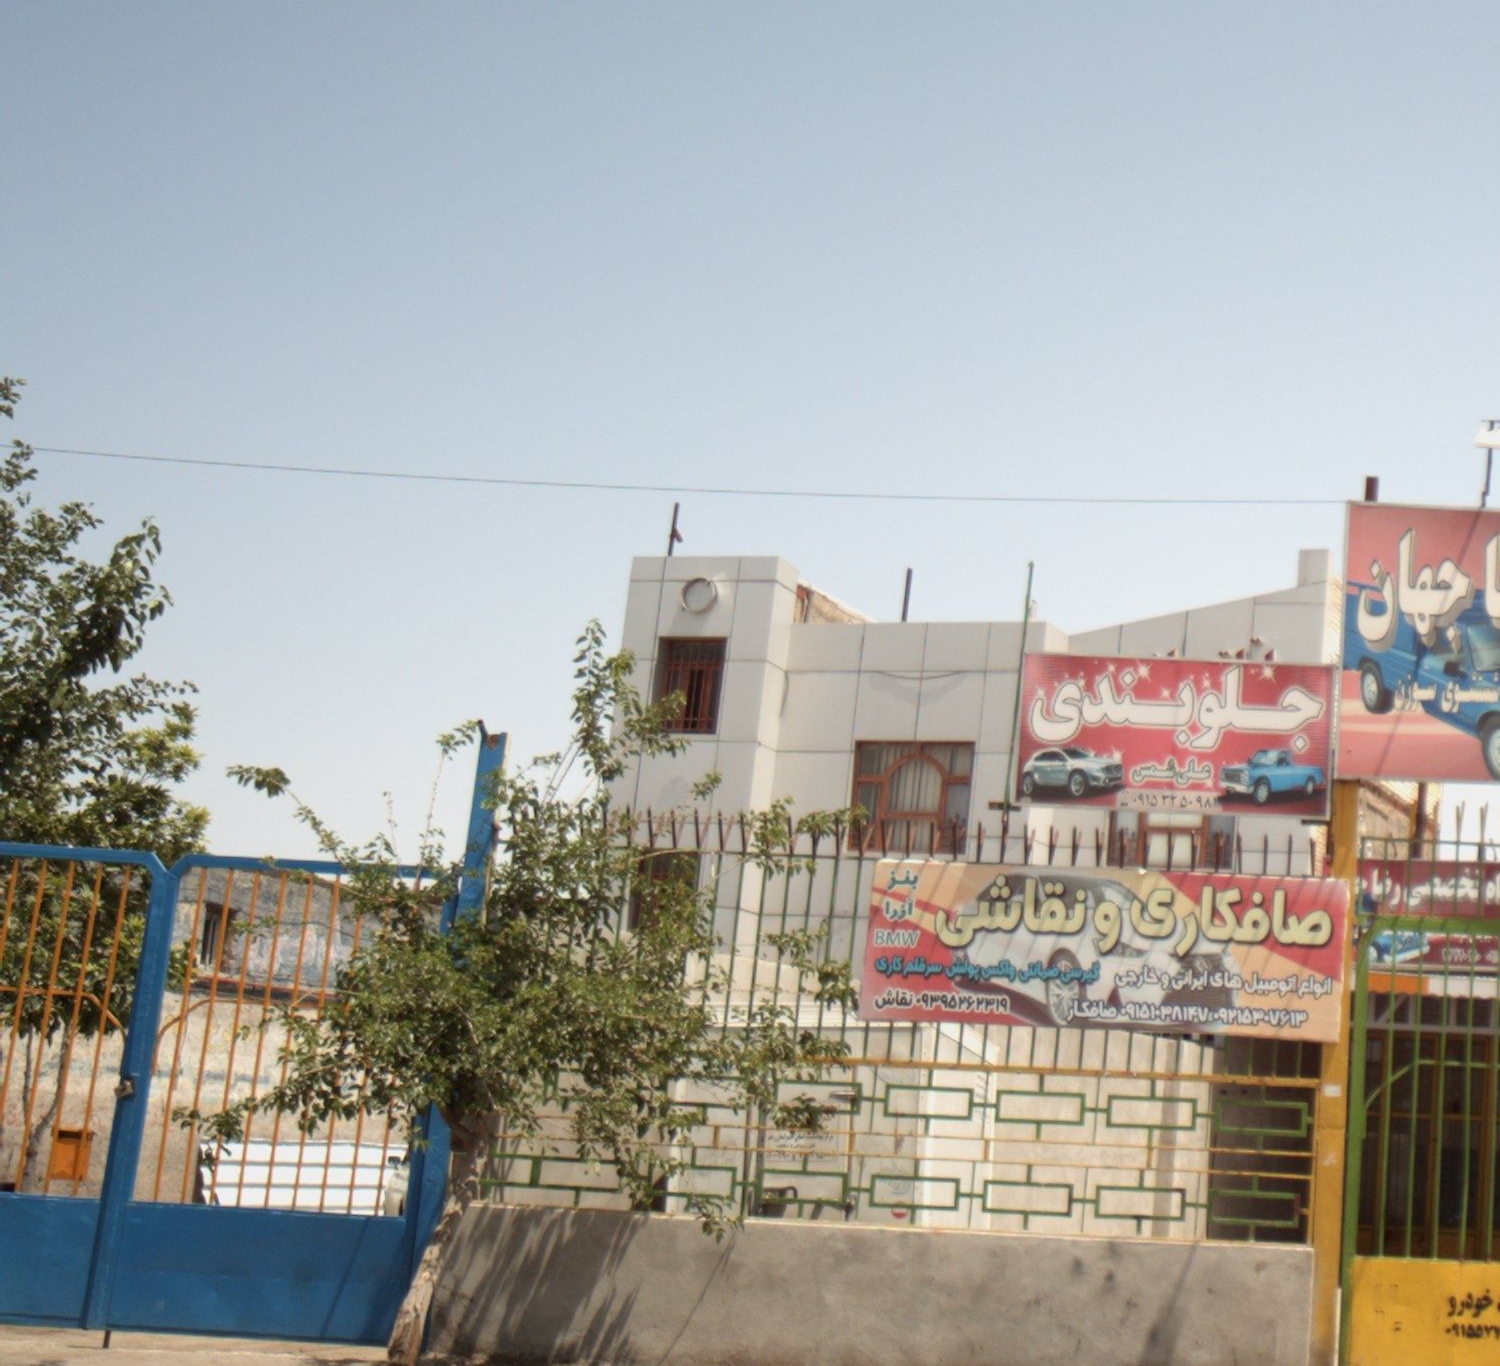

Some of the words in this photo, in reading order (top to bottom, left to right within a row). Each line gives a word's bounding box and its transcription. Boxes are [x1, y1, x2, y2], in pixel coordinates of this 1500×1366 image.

[1357, 528, 1472, 655] جهان
[1175, 756, 1213, 786] علی
[886, 869, 919, 892] بنز
[935, 873, 1088, 950] نقاشی
[1129, 881, 1332, 959] صافکاری
[1095, 898, 1123, 953] و
[874, 929, 920, 948] BMW
[1171, 967, 1209, 991] ایرانی
[1209, 969, 1244, 991] های
[1245, 971, 1298, 996] اتومبیل
[1298, 975, 1332, 999] انواع
[874, 988, 913, 1009] نقاش
[1066, 1001, 1118, 1024] صافکار
[1446, 1288, 1494, 1318] خودرو
